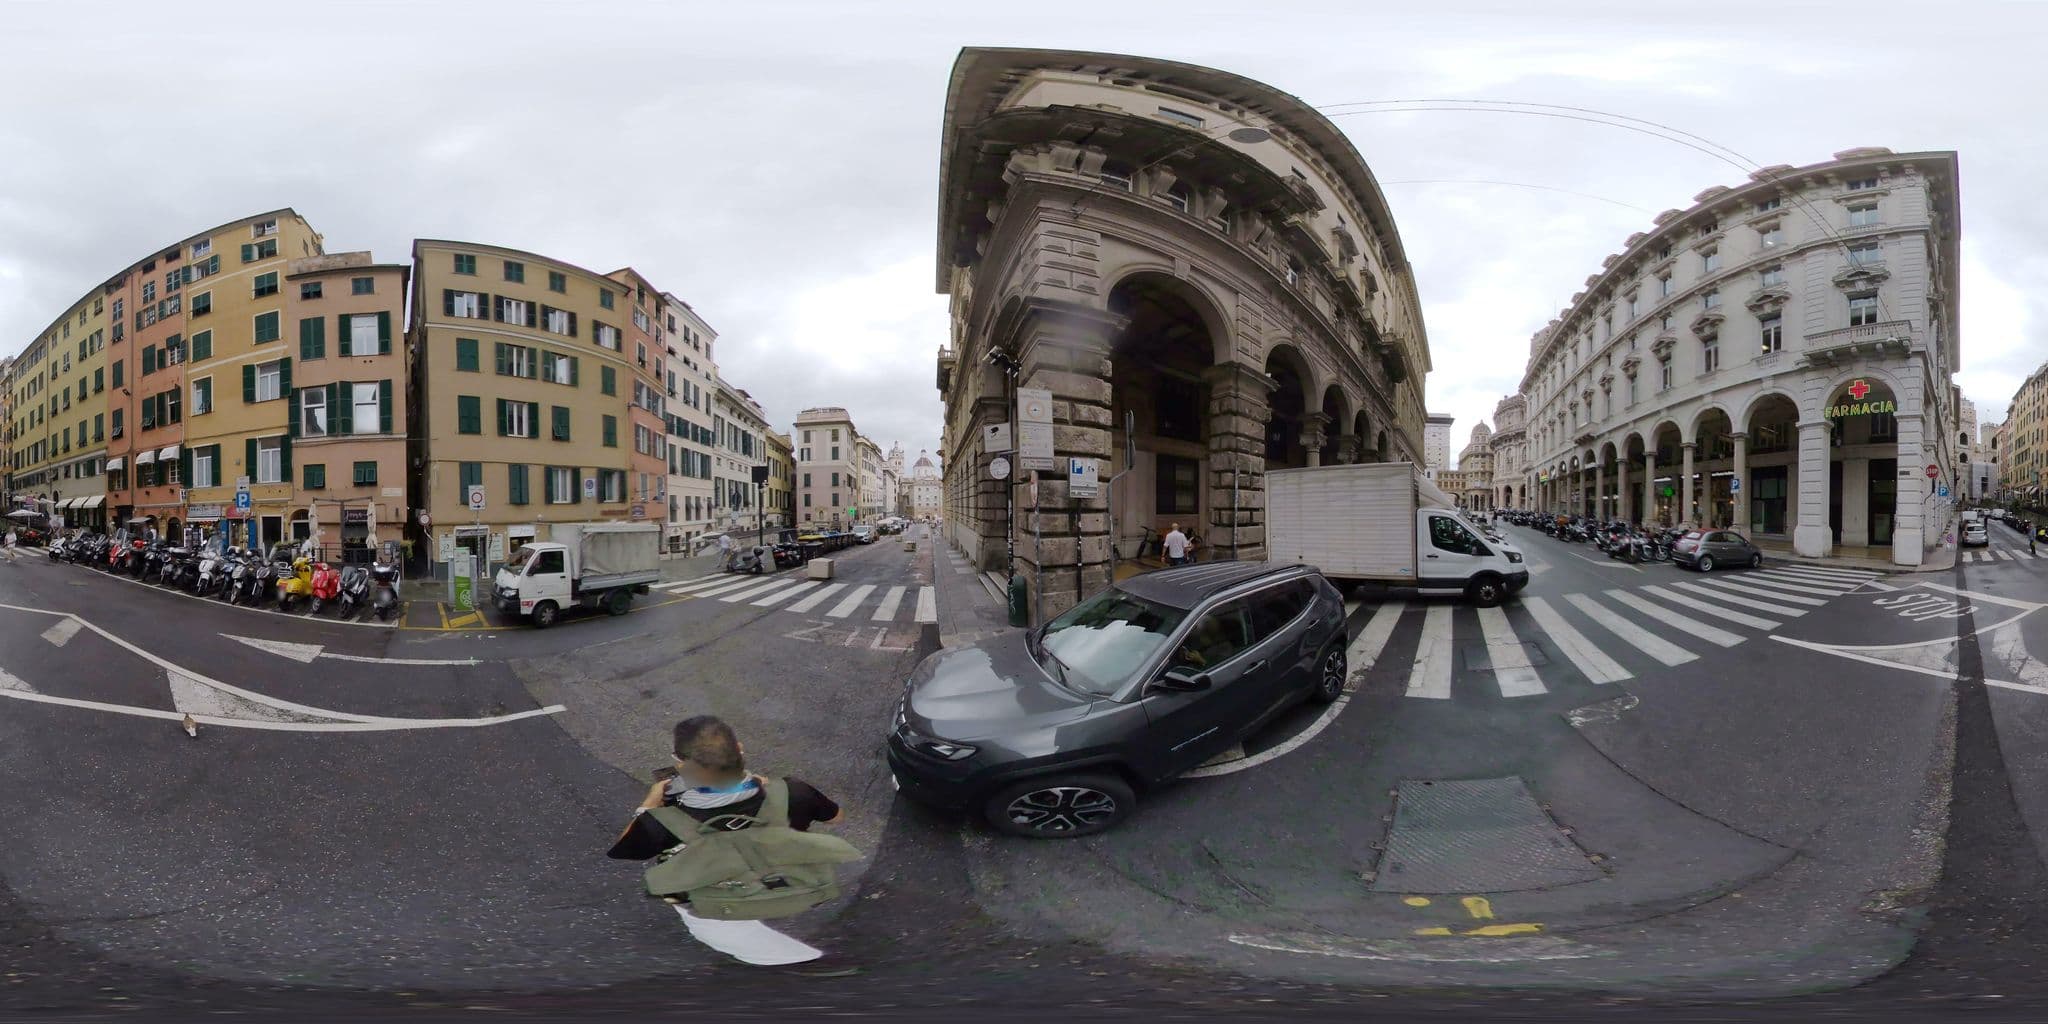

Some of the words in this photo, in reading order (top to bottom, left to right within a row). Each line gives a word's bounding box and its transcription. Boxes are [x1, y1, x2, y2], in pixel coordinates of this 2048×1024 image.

[1825, 400, 1896, 418] FARMACIA
[238, 493, 248, 507] P
[1872, 593, 1979, 622] STOP
